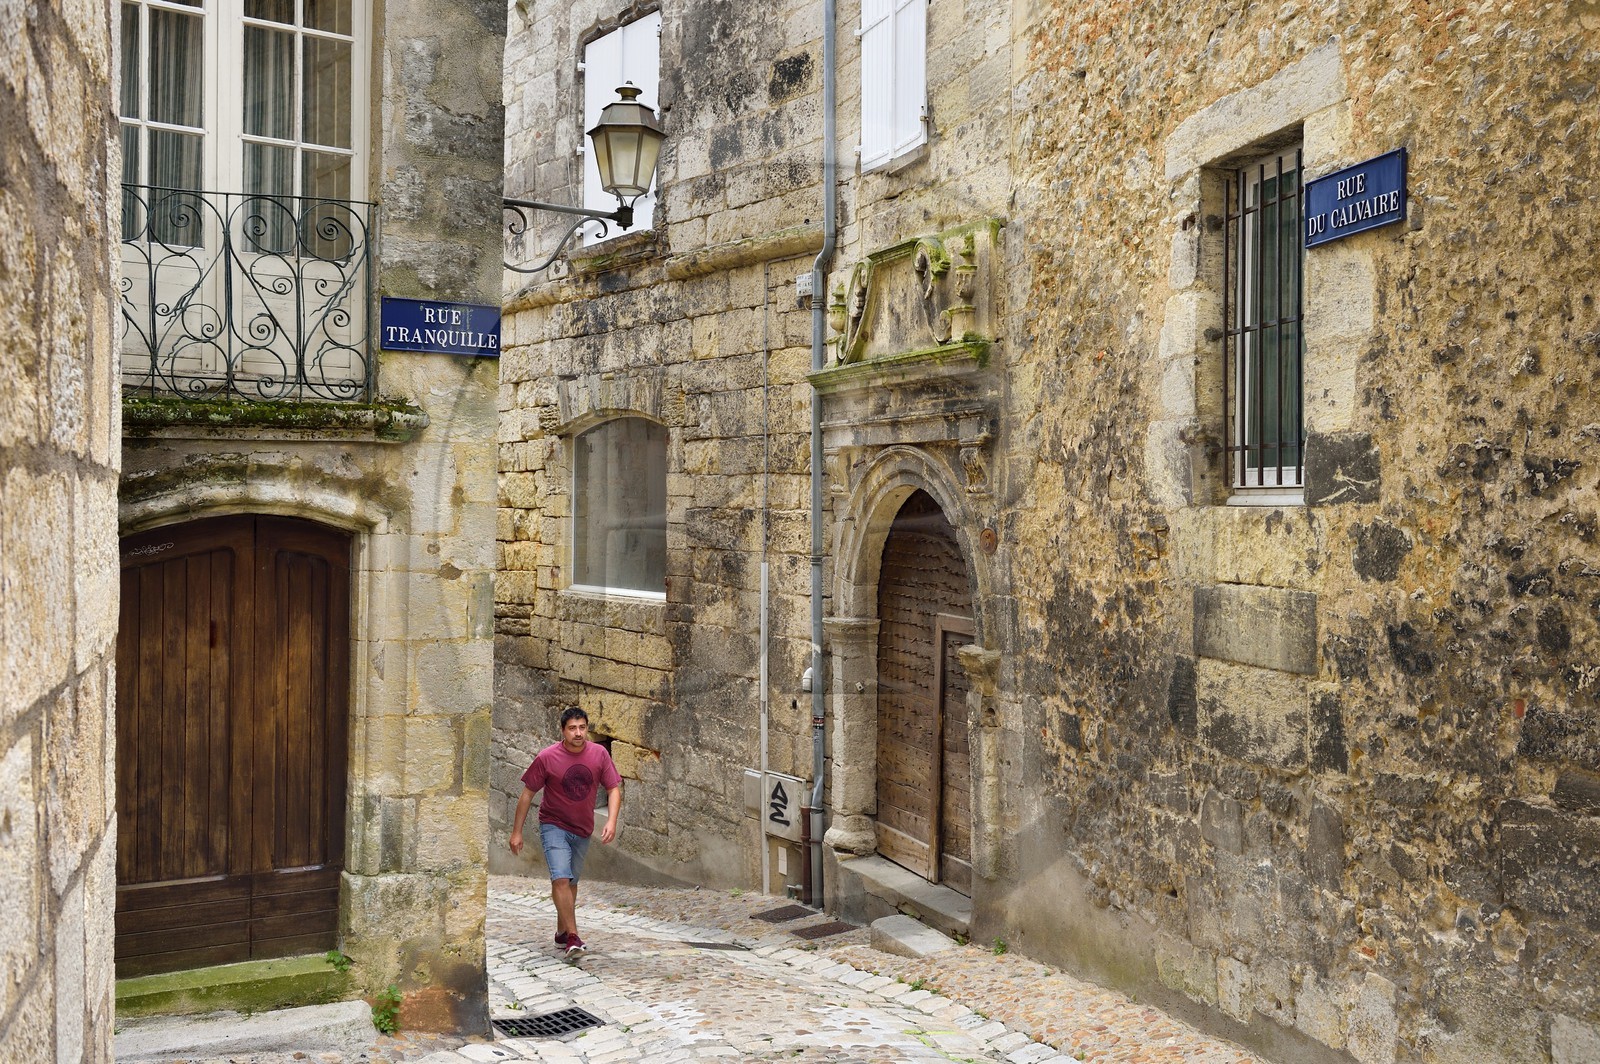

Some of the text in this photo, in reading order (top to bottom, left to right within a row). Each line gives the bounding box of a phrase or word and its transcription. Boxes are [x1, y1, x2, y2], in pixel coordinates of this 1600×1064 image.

[1337, 173, 1365, 200] RUE
[1308, 190, 1400, 237] DU CALVAIRE
[424, 307, 462, 325] RUE
[386, 326, 498, 349] TRANQUILLE
